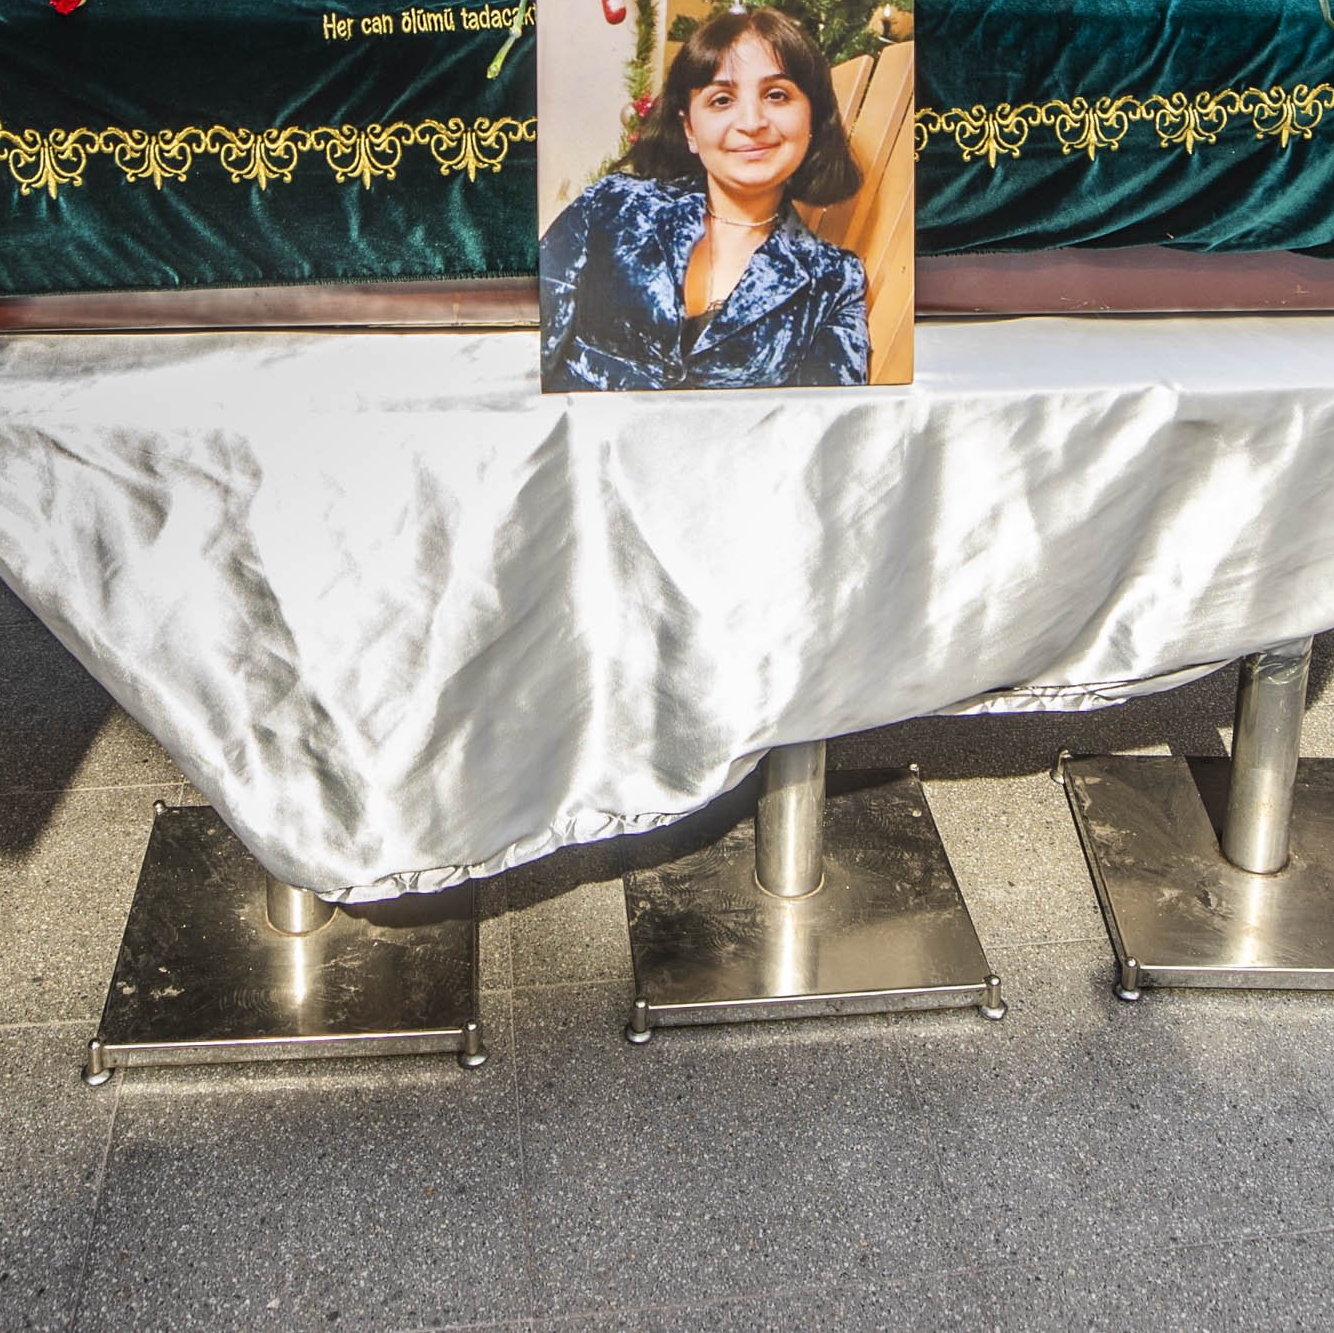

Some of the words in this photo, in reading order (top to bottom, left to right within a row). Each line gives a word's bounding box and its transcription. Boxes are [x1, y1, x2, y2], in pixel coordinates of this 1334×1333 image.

[323, 13, 354, 41] Her
[361, 14, 394, 35] can
[401, 7, 455, 34] ölümü
